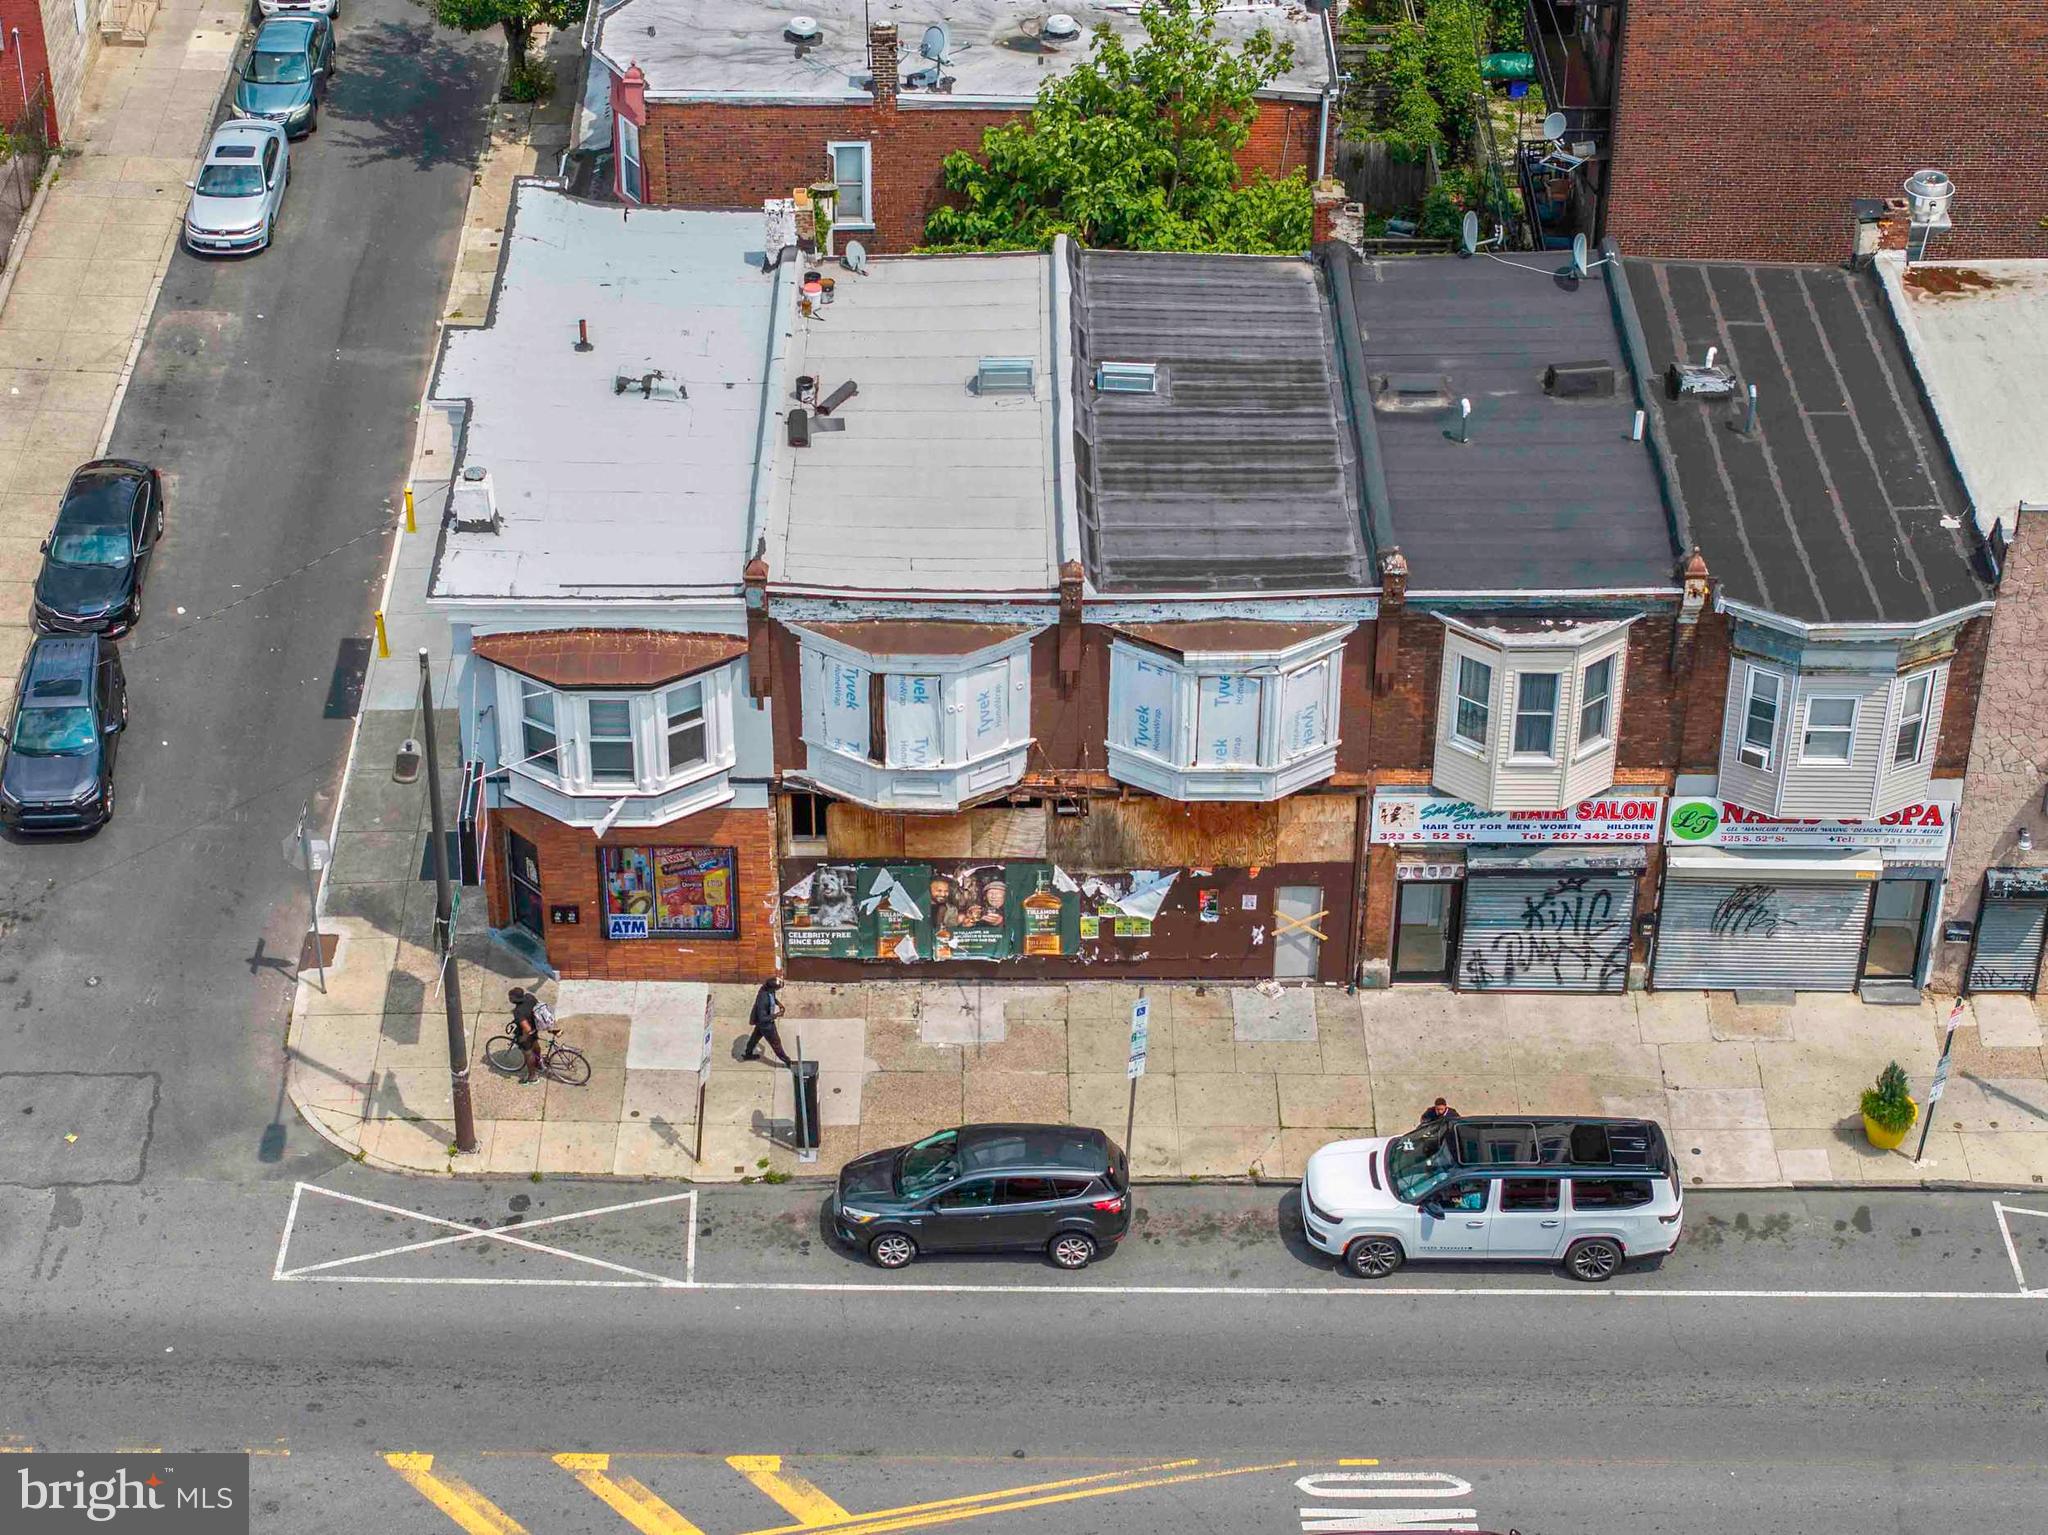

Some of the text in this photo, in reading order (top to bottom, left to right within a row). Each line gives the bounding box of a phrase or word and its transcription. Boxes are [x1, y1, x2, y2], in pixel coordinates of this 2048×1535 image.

[845, 667, 860, 711] Tyvek
[898, 675, 907, 706] meWrap
[913, 677, 929, 705] vek
[976, 689, 994, 737] Tyvek
[1134, 704, 1150, 749] Tyvek
[1302, 703, 1318, 747] Tyvek
[912, 736, 929, 765] Tyv
[1214, 738, 1228, 764] vek
[1576, 801, 1658, 821] SALON
[1552, 832, 1650, 840] 267-342-2658
[612, 920, 646, 933] ATM
